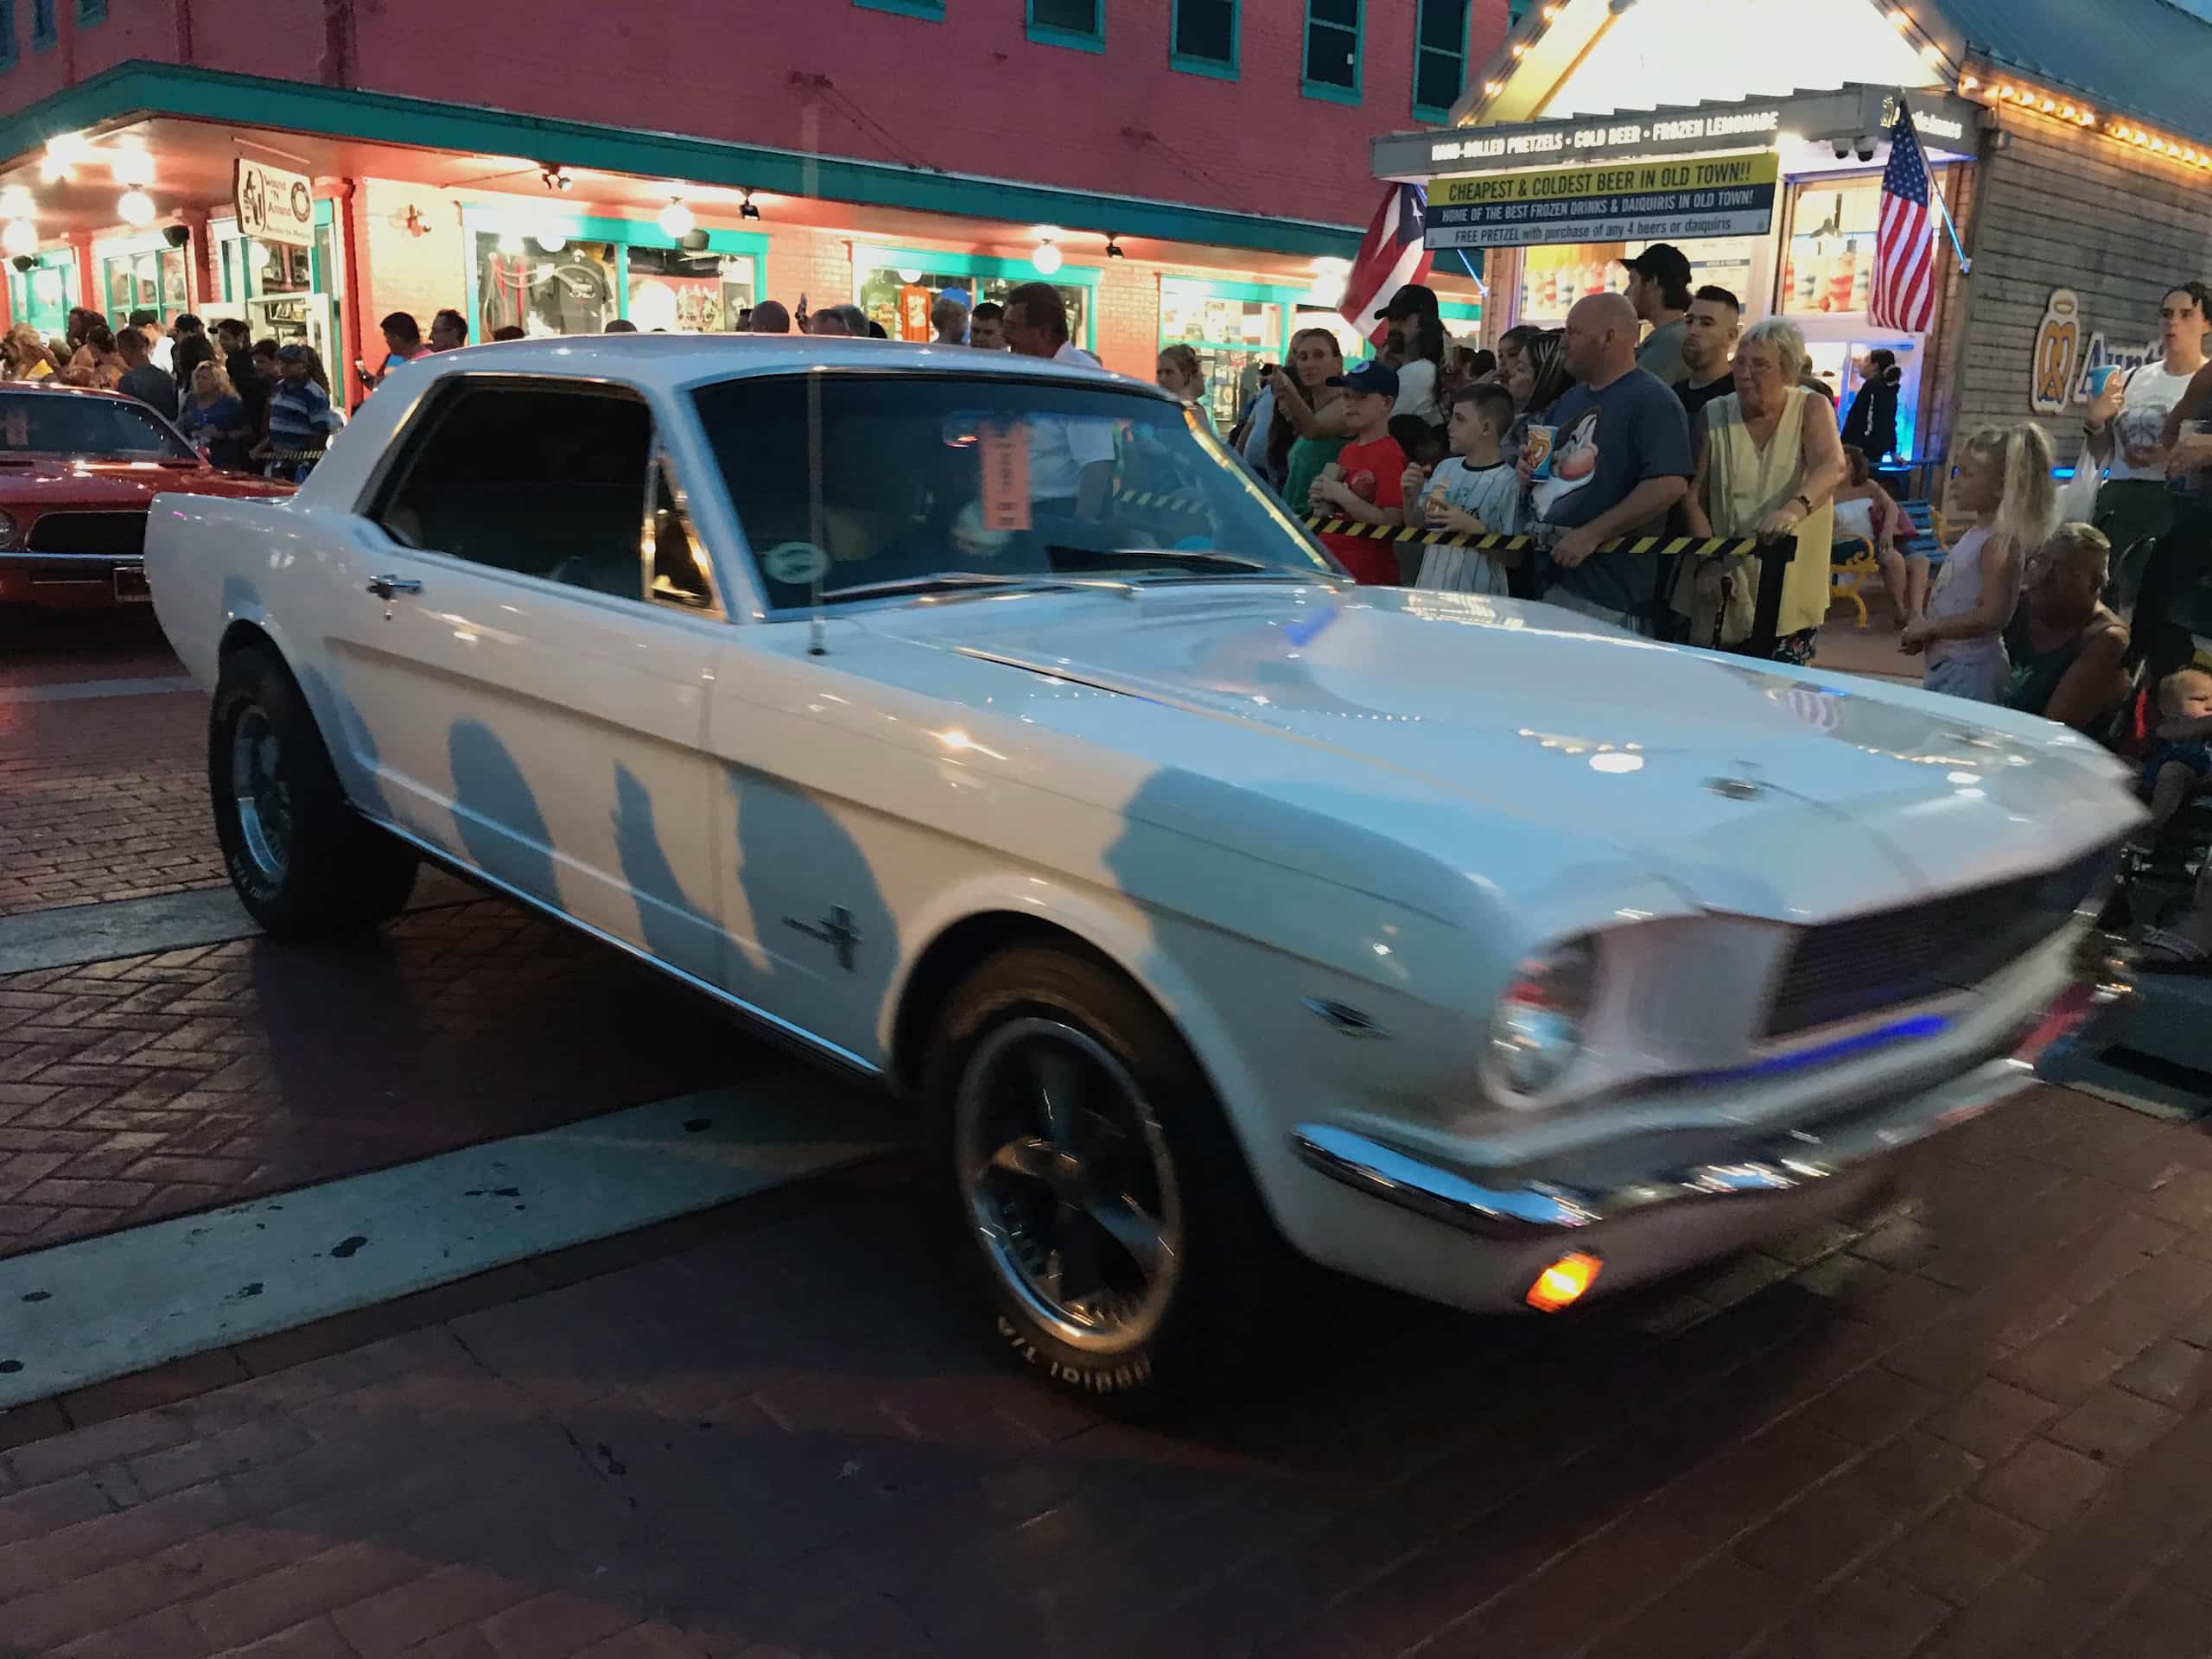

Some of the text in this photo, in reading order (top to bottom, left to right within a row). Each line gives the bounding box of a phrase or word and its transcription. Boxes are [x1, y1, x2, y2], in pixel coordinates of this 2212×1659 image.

[1507, 132, 1563, 155] PRETZELS
[1573, 129, 1606, 149] COLD
[1608, 125, 1641, 145] BEER
[1652, 118, 1704, 141] FROZEN
[1706, 111, 1779, 137] LEMONADE
[1449, 161, 1751, 201] CHEAPEST & COLDEST BEER IN OLD TOWN!!
[1441, 189, 1755, 223] HOME OF THE BEST FROZEN DRINKS & DAIQUIRIS IN OLD TOWN!
[1455, 218, 1732, 244] FREE PRETZEL with purchase of any 4 beers or daiquiris
